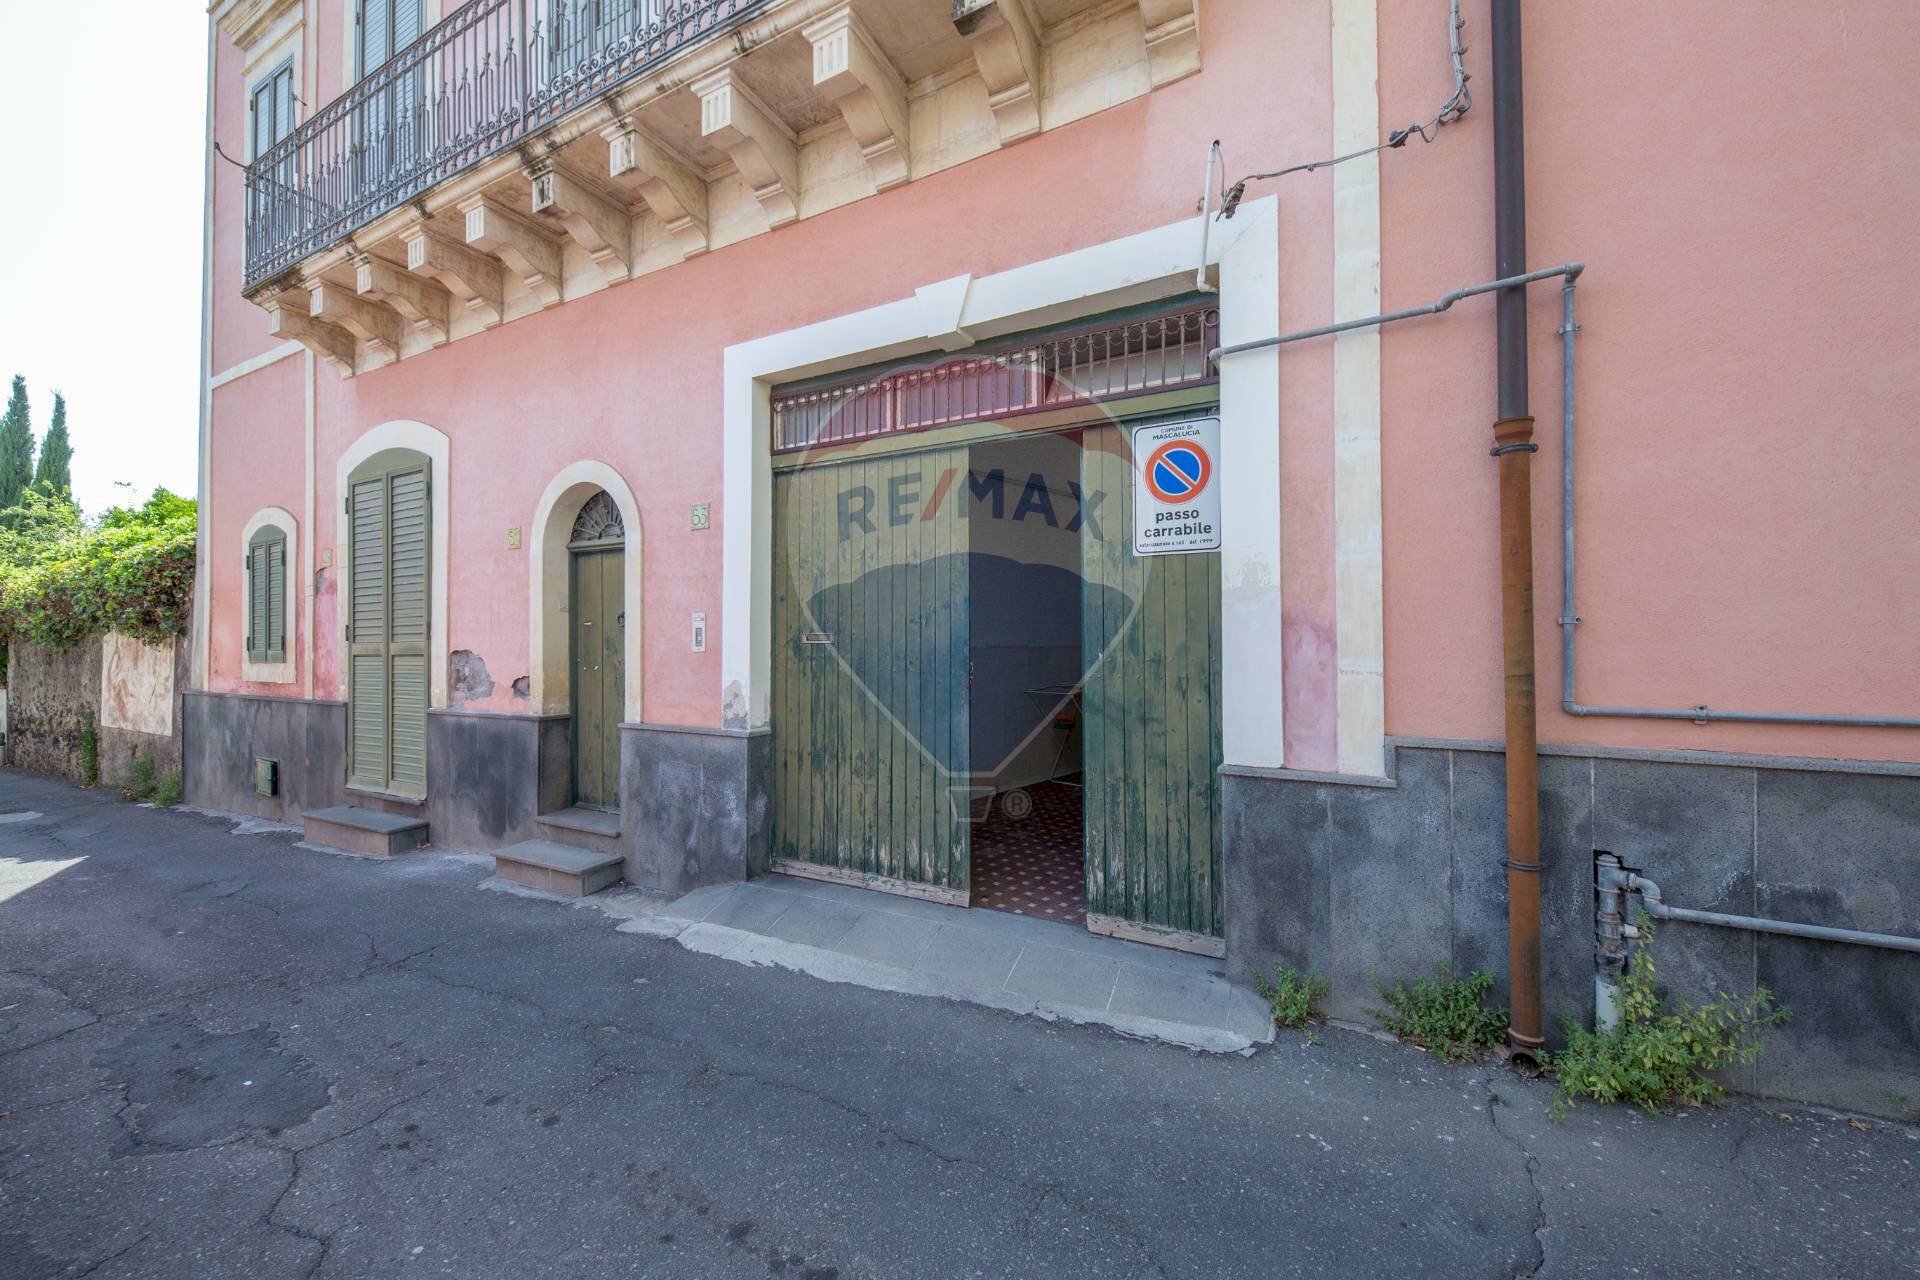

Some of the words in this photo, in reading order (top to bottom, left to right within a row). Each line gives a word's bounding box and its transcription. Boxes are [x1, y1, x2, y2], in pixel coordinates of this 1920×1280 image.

[1152, 429, 1200, 440] MASCALUCIA
[1156, 509, 1199, 524] passo
[1144, 522, 1212, 538] carrabile
